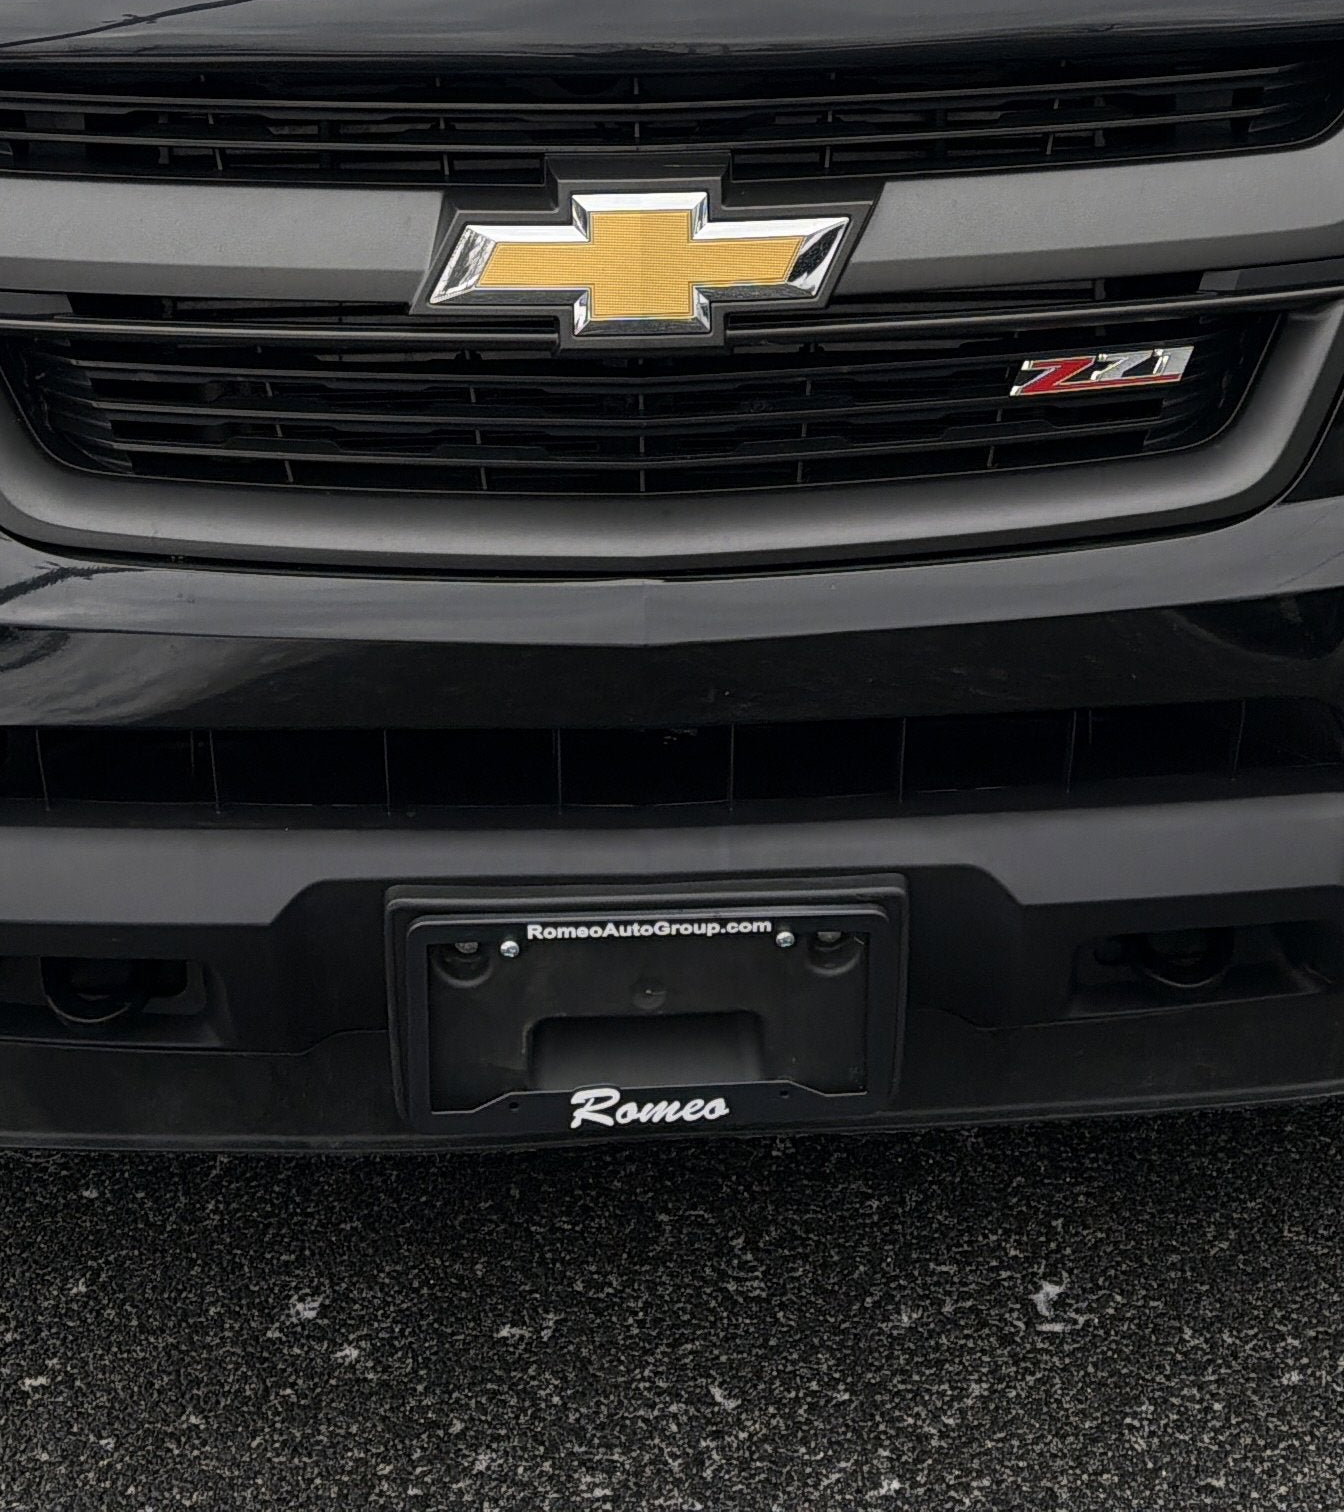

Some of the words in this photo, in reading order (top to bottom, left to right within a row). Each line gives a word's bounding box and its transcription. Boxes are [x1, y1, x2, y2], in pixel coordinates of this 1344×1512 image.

[1010, 346, 1195, 397] Z71
[526, 920, 772, 940] RomeoAutoGroup.com
[570, 1088, 730, 1129] Romeo
